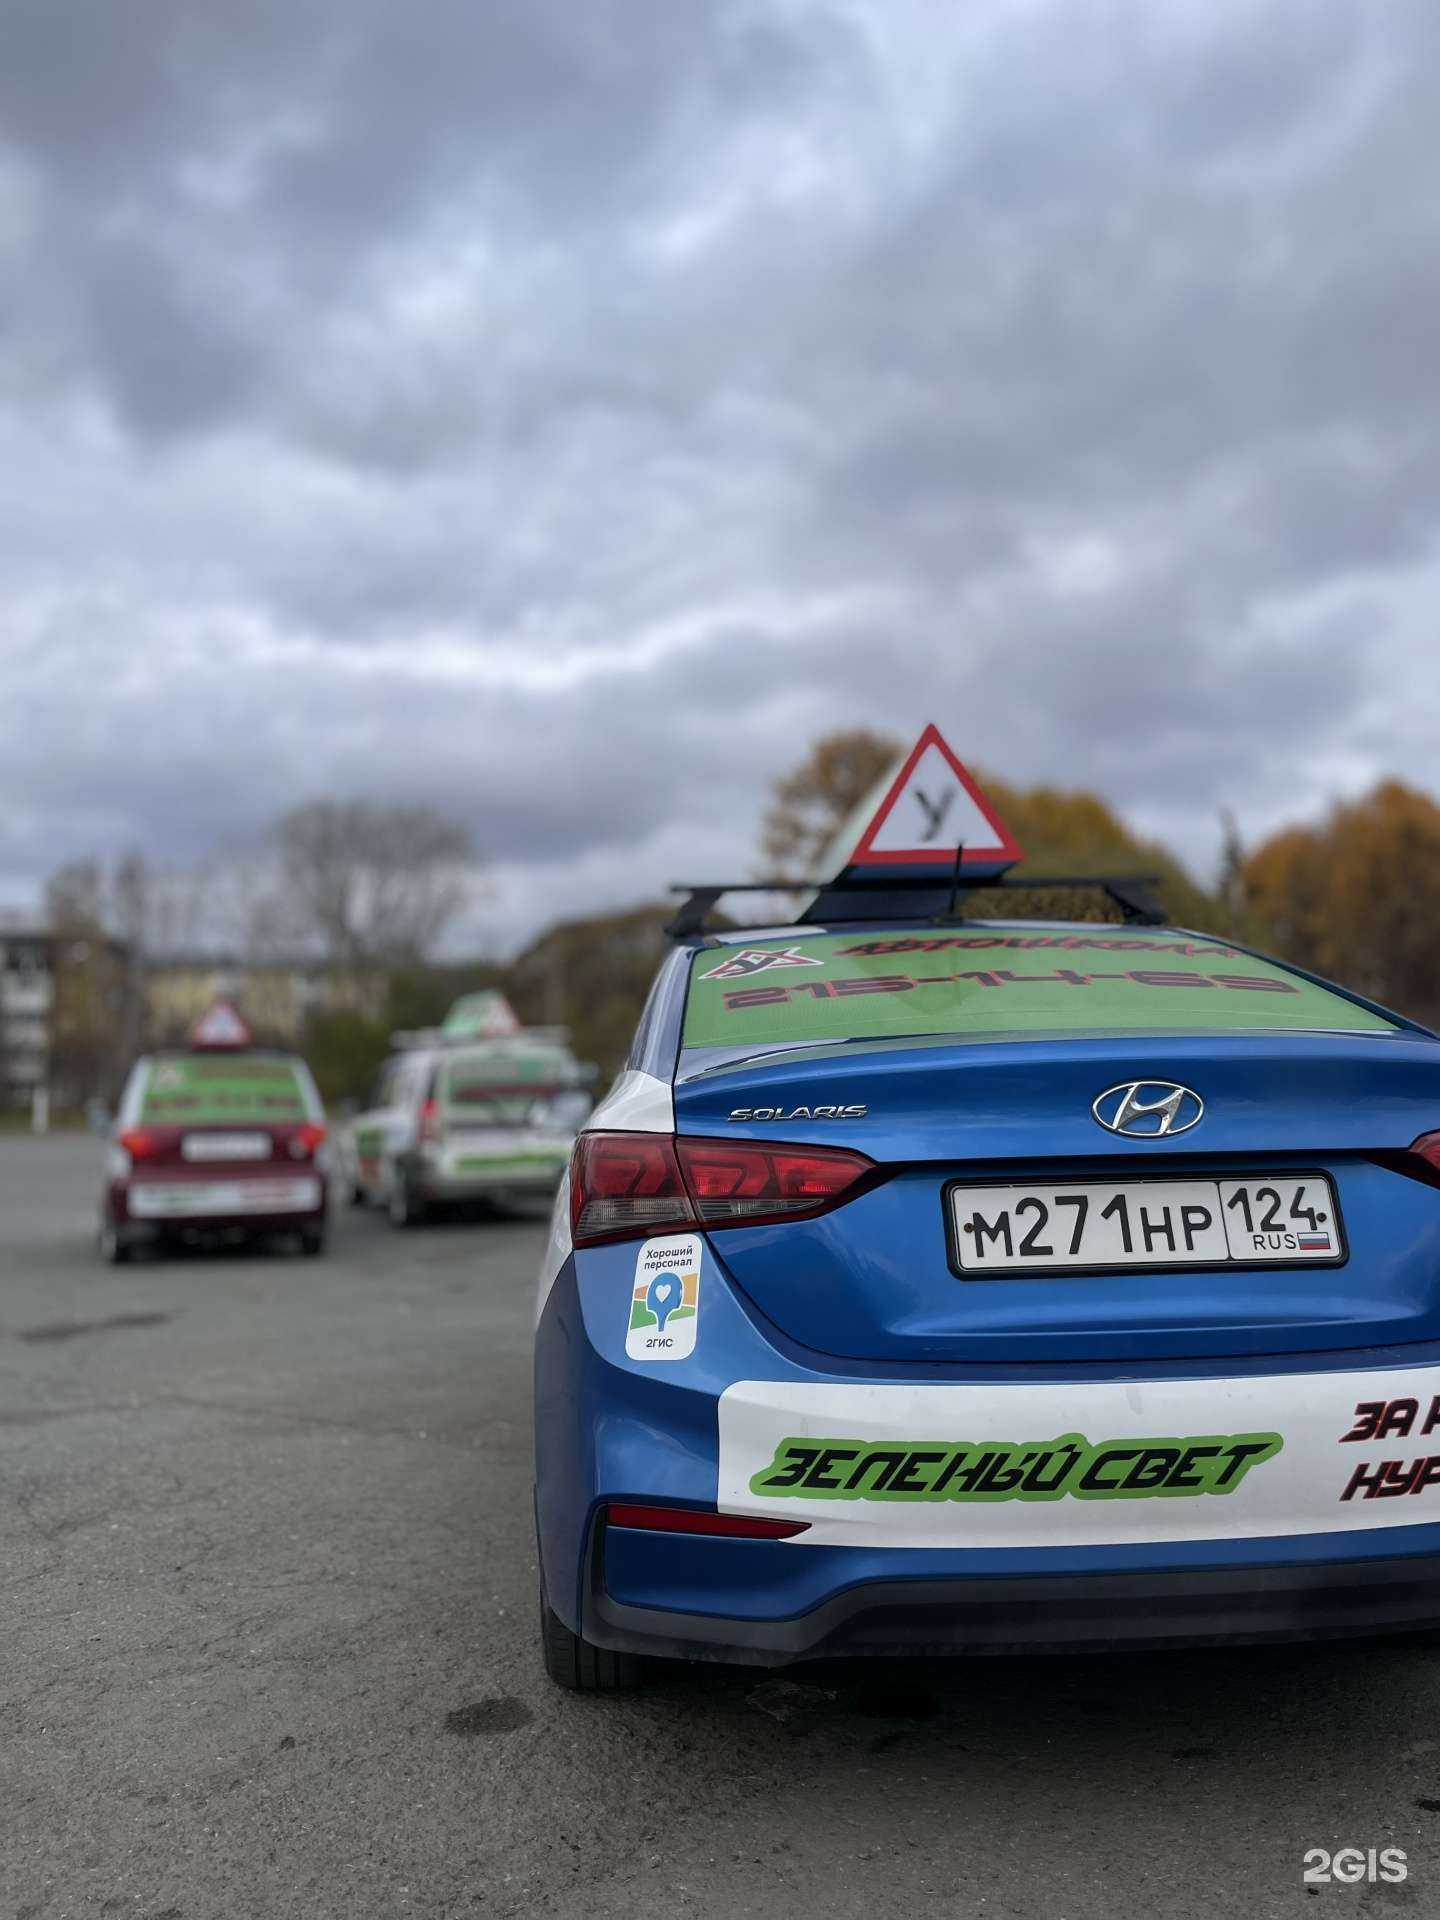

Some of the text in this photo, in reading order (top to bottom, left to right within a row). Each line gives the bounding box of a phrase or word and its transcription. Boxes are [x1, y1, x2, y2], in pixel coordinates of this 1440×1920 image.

[722, 969, 1301, 1010] 215-14-69
[728, 1104, 868, 1122] SOLARIS
[1227, 1186, 1318, 1232] 124
[1253, 1232, 1298, 1251] RUS
[646, 1244, 694, 1261] Хороший
[644, 1257, 693, 1272] персонал
[646, 1338, 674, 1348] 2ГИС
[1337, 1397, 1420, 1444] ЗА
[760, 1442, 1273, 1492] ЗЕЛЕНЫЙ СВЕТ
